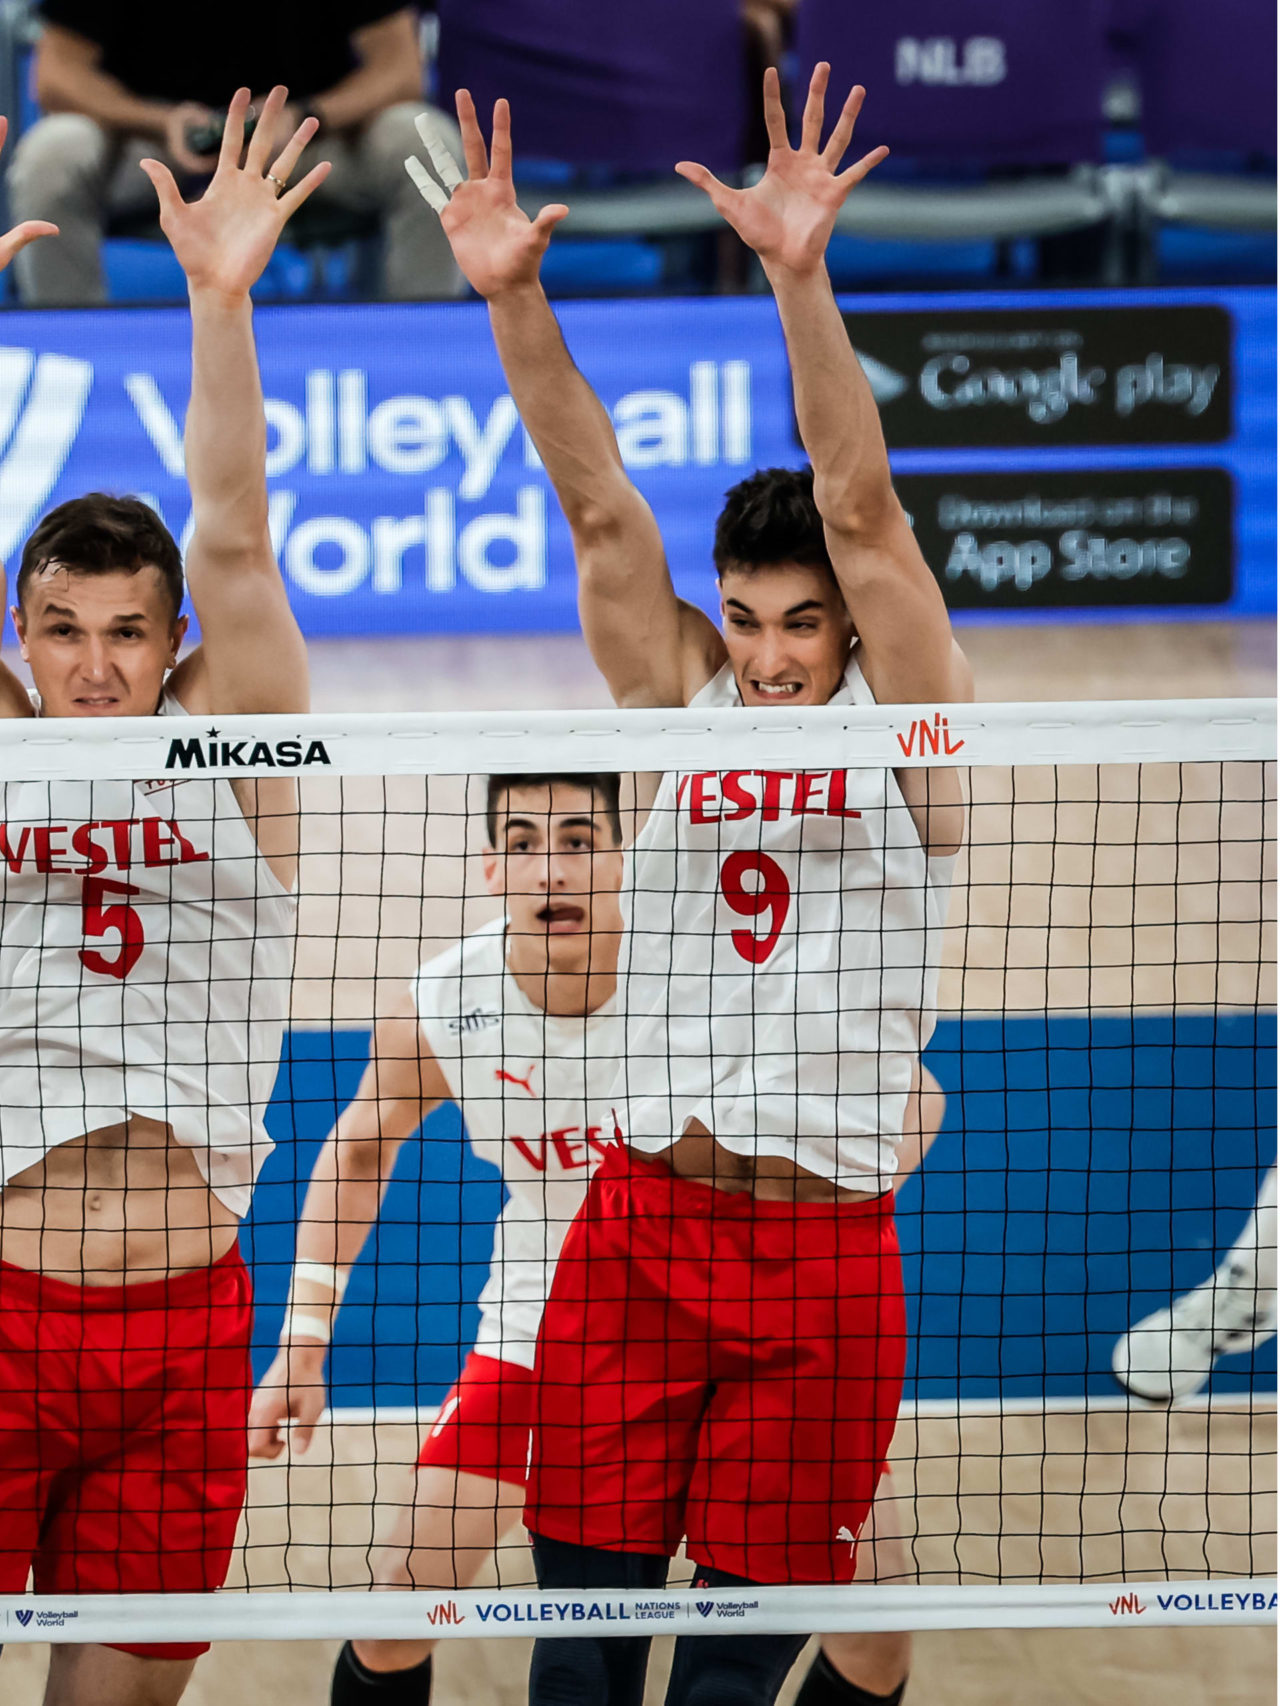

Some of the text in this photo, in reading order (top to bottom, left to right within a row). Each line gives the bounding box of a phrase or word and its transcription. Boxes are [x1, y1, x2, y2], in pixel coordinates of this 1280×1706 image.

[894, 37, 1007, 86] NLB
[1116, 352, 1220, 417] play
[124, 360, 750, 500] Volleyall
[945, 530, 1191, 591] App Store
[165, 737, 331, 769] MIKASA
[897, 711, 965, 757] VNL
[78, 876, 144, 979] 5
[720, 850, 790, 964] 9
[509, 1127, 607, 1171] VES
[36, 1610, 78, 1619] Volleyball
[37, 1619, 65, 1627] World
[427, 1600, 680, 1625] VNL VOLLEYBALL NATIONS
[635, 1611, 675, 1619] LEAGUE
[716, 1601, 759, 1611] Volleyball
[1109, 1592, 1147, 1615] VNL
